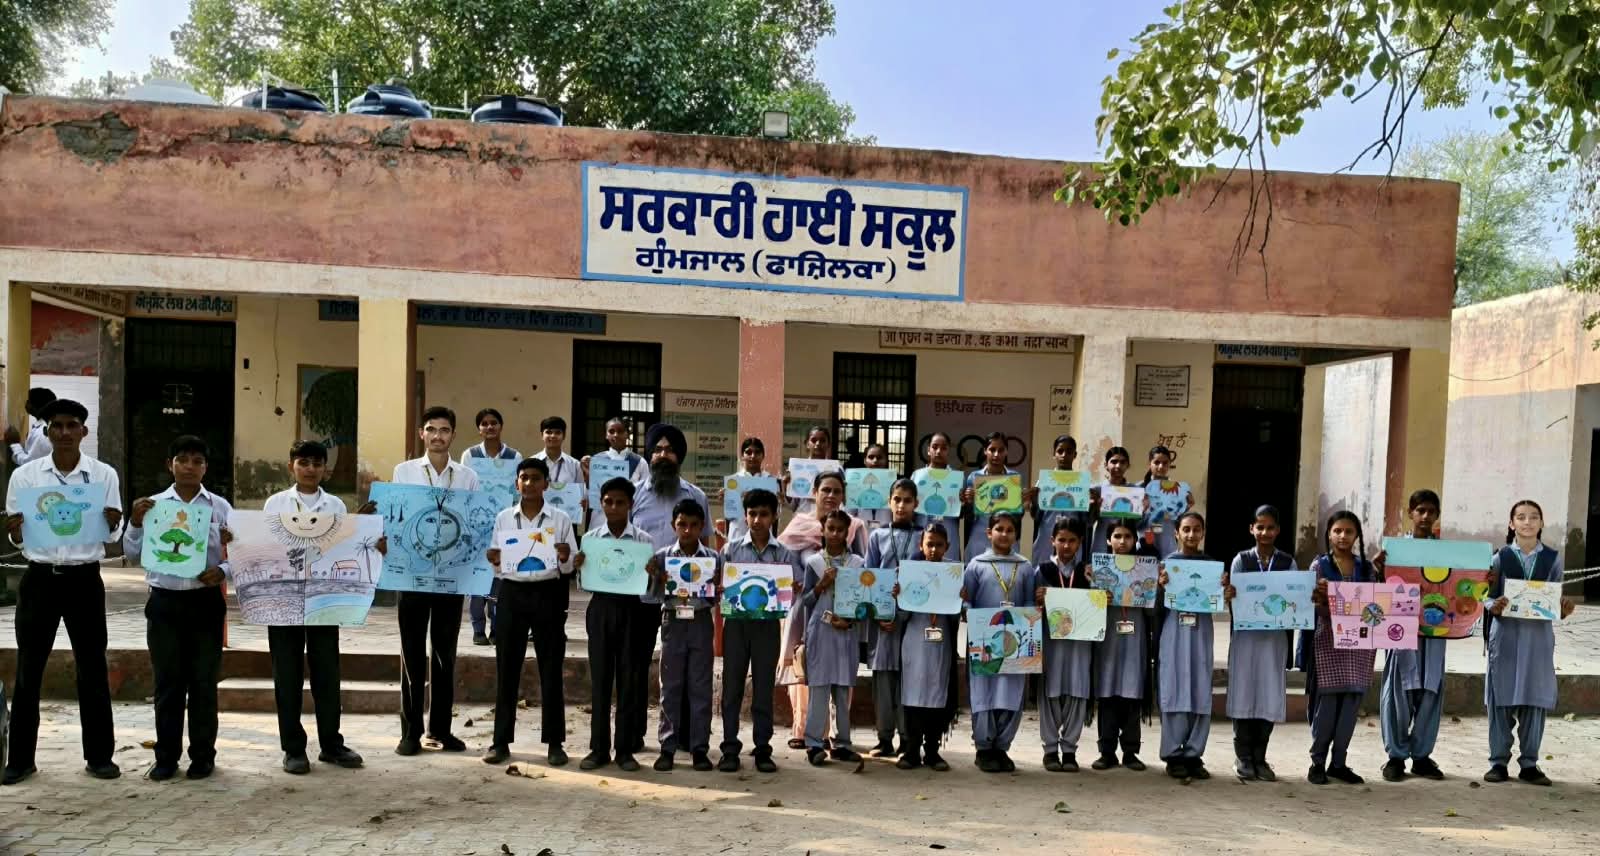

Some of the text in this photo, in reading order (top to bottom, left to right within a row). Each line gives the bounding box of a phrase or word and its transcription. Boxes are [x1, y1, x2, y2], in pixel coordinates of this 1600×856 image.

[599, 181, 956, 271] ਸਰਕਾਰੀ ਹਾਈ ਸਕੂਲ
